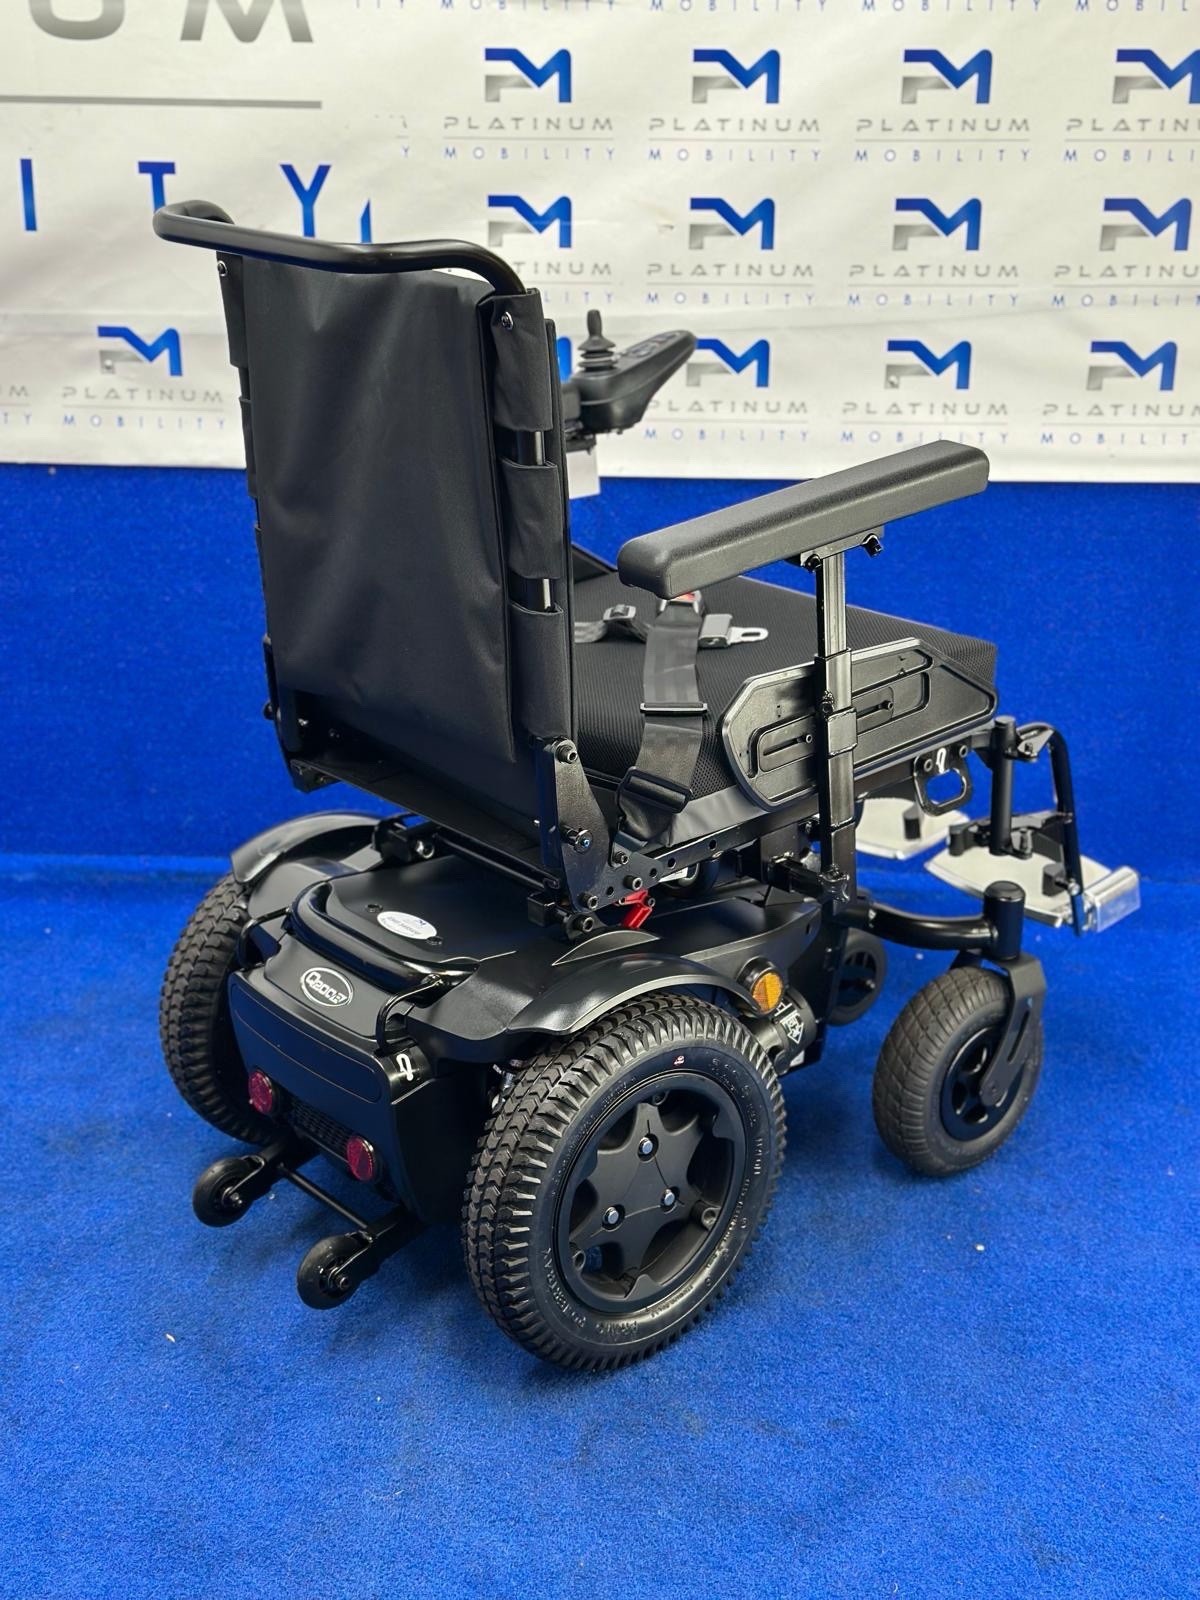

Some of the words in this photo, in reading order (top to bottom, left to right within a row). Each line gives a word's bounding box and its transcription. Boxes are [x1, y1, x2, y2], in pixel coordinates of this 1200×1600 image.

[441, 0, 617, 10] MOBILITY
[650, 0, 826, 11] MOBILITY
[862, 0, 1040, 11] MOBILITY
[444, 116, 613, 131] PLATINUM
[649, 117, 820, 132] PLATINUM
[856, 118, 1030, 132] PLATINUM
[1066, 118, 1200, 132] PLATIN
[444, 146, 614, 160] MOBILITY
[648, 148, 820, 162] MOBILITY
[854, 149, 1029, 162] MOBILITY
[513, 261, 612, 275] TINUM
[646, 263, 813, 277] PLATINUM
[849, 264, 1018, 278] PLATINUM
[544, 291, 612, 303] LITY
[647, 292, 814, 305] MOBILITY
[848, 293, 1018, 307] MOBILITY
[62, 387, 223, 403] PLATINUM
[647, 399, 807, 414] PLATINUM
[842, 402, 1008, 416] PLATINUM
[63, 415, 224, 429] MOBILITY
[644, 428, 808, 441] MOBILITY
[840, 431, 1008, 444] MOBILITY
